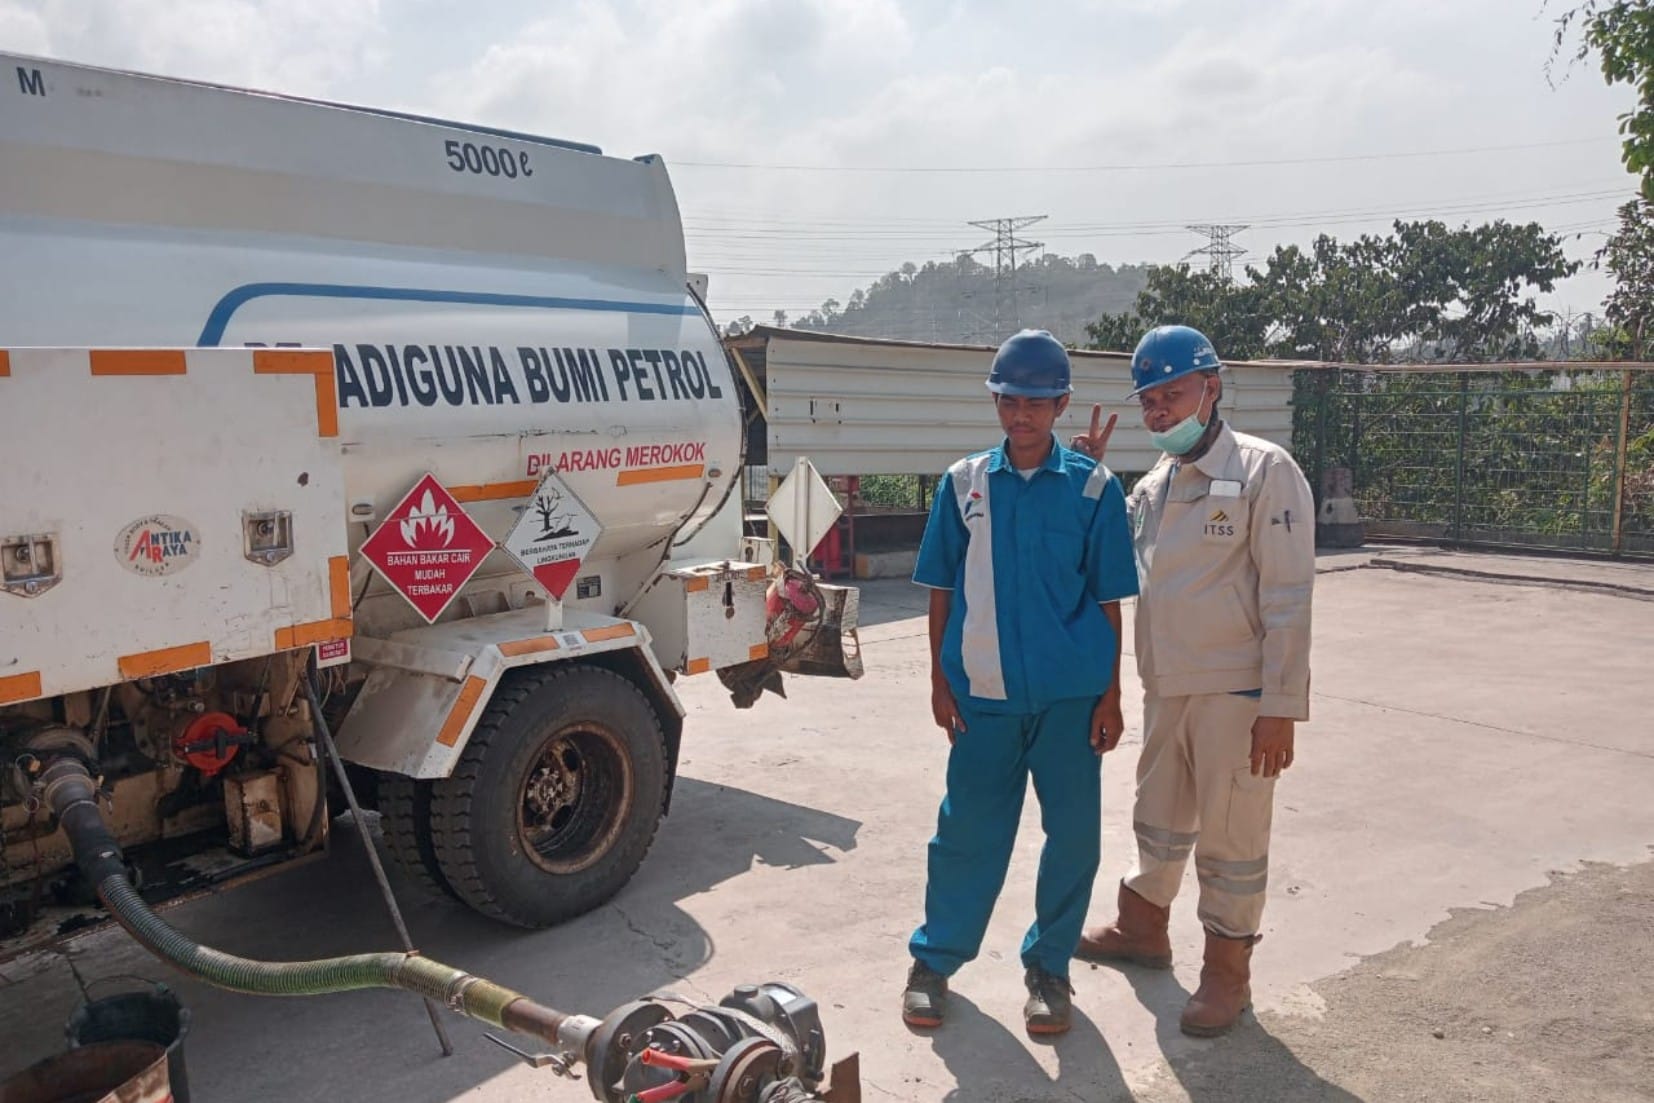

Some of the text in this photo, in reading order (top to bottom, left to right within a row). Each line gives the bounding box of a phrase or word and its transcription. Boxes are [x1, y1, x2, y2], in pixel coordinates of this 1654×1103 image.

[333, 343, 723, 408] ADIGUNA BUMI PETROL
[625, 442, 706, 467] MEROKOK
[1204, 523, 1234, 536] ITSS
[128, 529, 192, 562] ANTIKA
[151, 543, 188, 563] RAYA
[387, 552, 471, 566] BAHAN BAKAR CAIR
[415, 569, 446, 580] MUDAH
[407, 584, 453, 596] TERBAKAR
